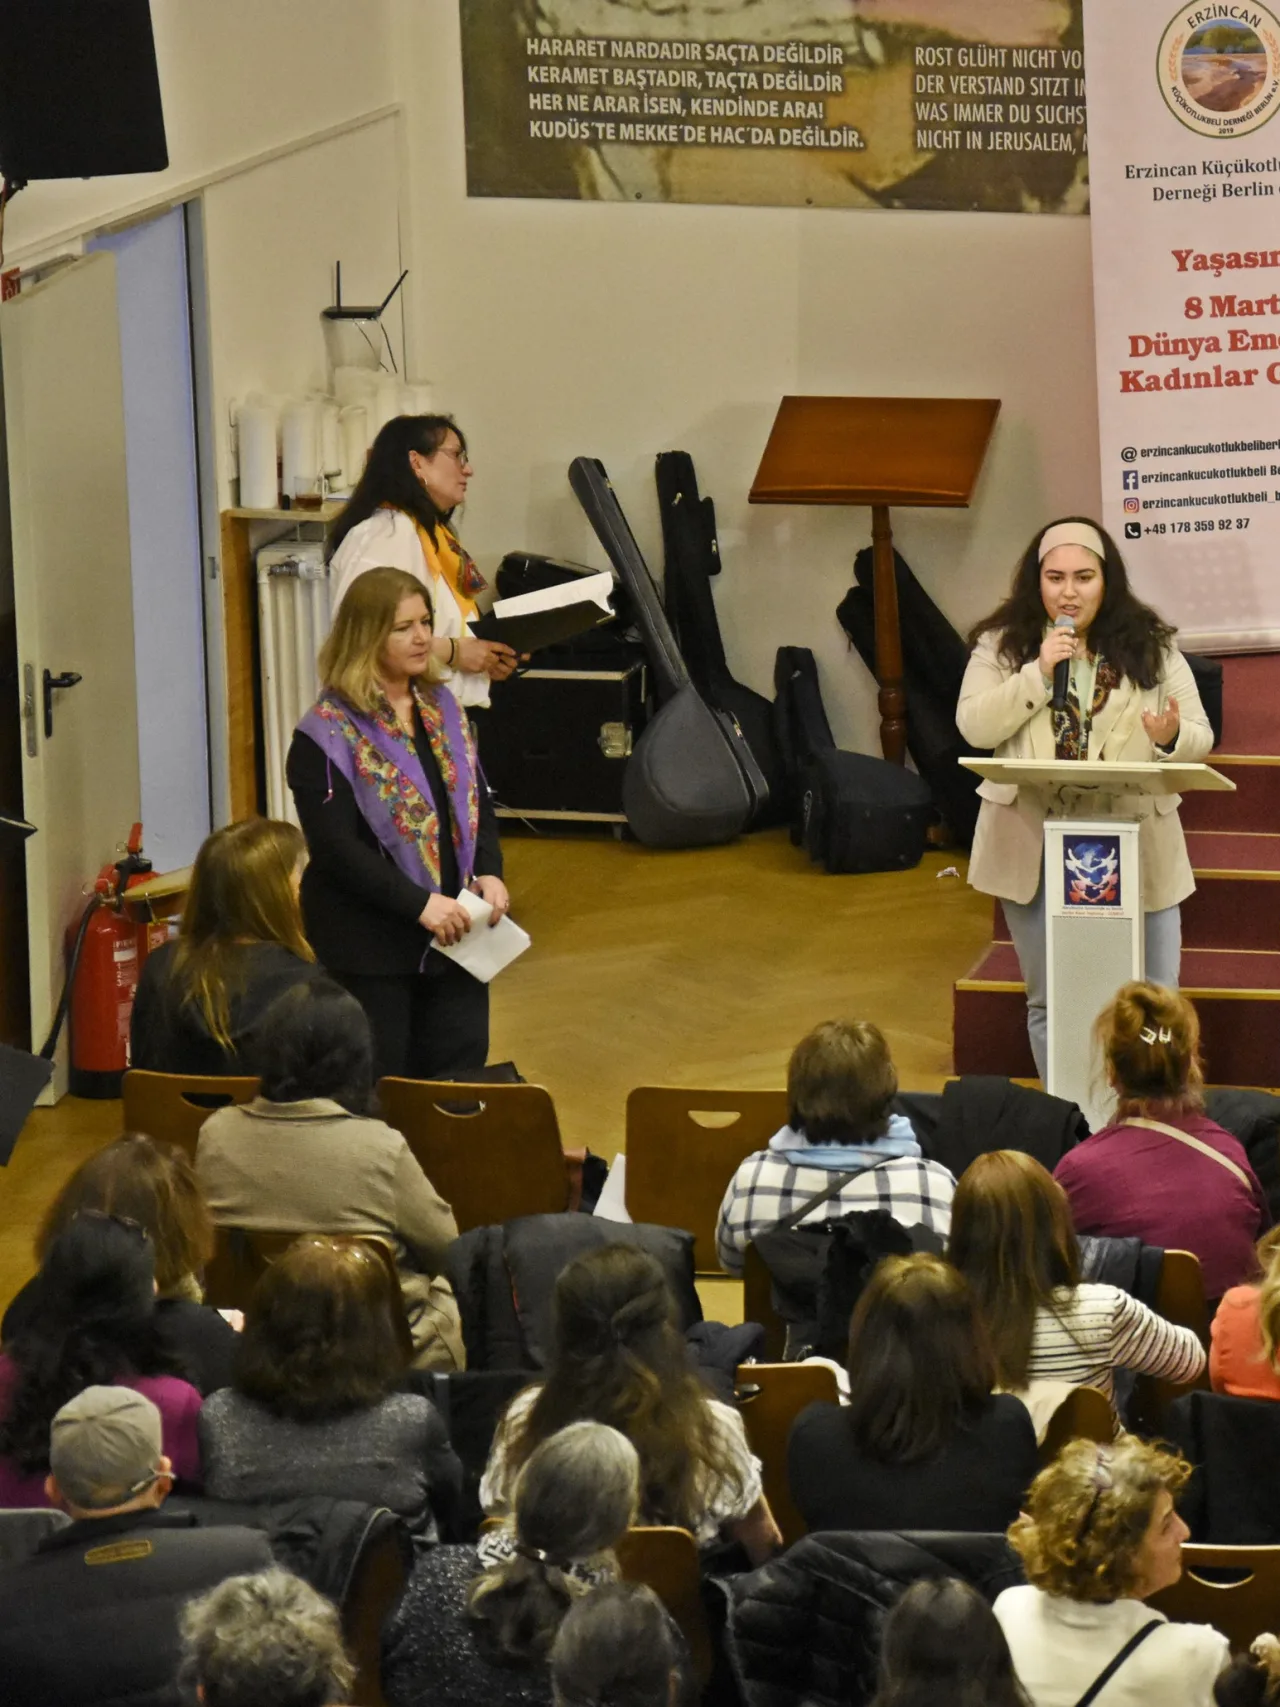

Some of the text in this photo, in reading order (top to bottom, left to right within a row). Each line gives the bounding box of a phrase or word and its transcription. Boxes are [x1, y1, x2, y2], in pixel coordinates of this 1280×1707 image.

[1187, 3, 1262, 29] ERZİNCAN
[526, 38, 844, 65] HARARET NARDADIR SAÇTA DEĞİLDİR
[915, 44, 1085, 69] ROST GLÜHT NICHT VO
[527, 66, 844, 93] KERAMET BAŞTADIR, TAÇTA DEĞİLDİR
[915, 75, 945, 94] DER
[949, 75, 1026, 96] VERSTAND
[1030, 77, 1069, 97] SITZT
[528, 92, 824, 120] HER NE ARAR İSEN, KENDİNDE ARA!
[916, 102, 948, 121] WAS
[954, 103, 1003, 123] IMMER
[1009, 104, 1030, 123] DU
[1223, 110, 1254, 126] DERNEĞİ
[1254, 93, 1274, 116] BERLİN
[779, 122, 864, 148] DEĞİLDİR.
[917, 130, 961, 149] NICHT
[967, 130, 982, 150] IN
[988, 132, 1077, 155] JERUSALEM,
[1218, 127, 1234, 135] 2019
[1125, 163, 1197, 180] Erzincan
[1152, 184, 1218, 203] Derneği
[1221, 182, 1274, 199] Berlin
[1184, 297, 1204, 320] 8
[1129, 332, 1222, 361] Dünya
[1119, 365, 1259, 393] Kadınlar
[1141, 466, 1267, 484] erzincankucukotlukbeli
[1143, 517, 1251, 536] +49 178 359 92 37
